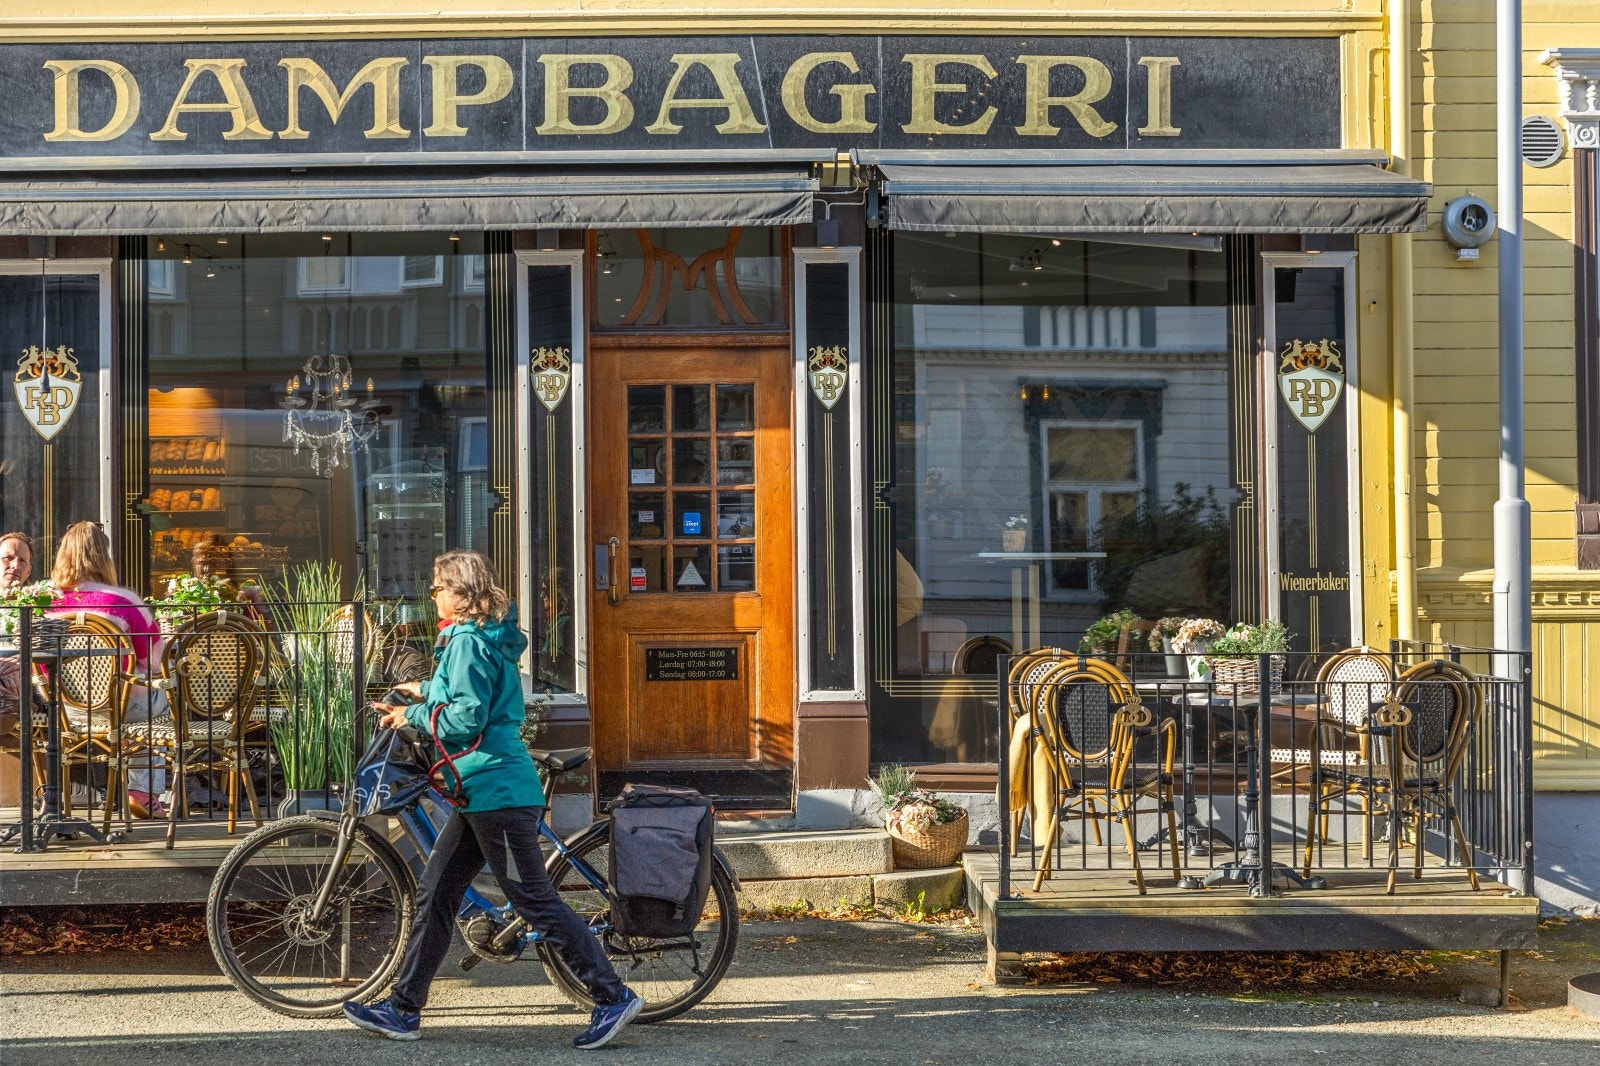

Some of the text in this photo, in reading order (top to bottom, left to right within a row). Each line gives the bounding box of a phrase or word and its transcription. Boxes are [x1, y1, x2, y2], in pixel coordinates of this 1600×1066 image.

[42, 51, 1182, 142] DAMPBAGERI
[1279, 571, 1350, 591] Wienerbakeri
[658, 650, 689, 658] Man-Fre
[659, 660, 726, 669] Lørdag 07:00-18:00
[659, 670, 726, 679] Søndag 08:00-17:00
